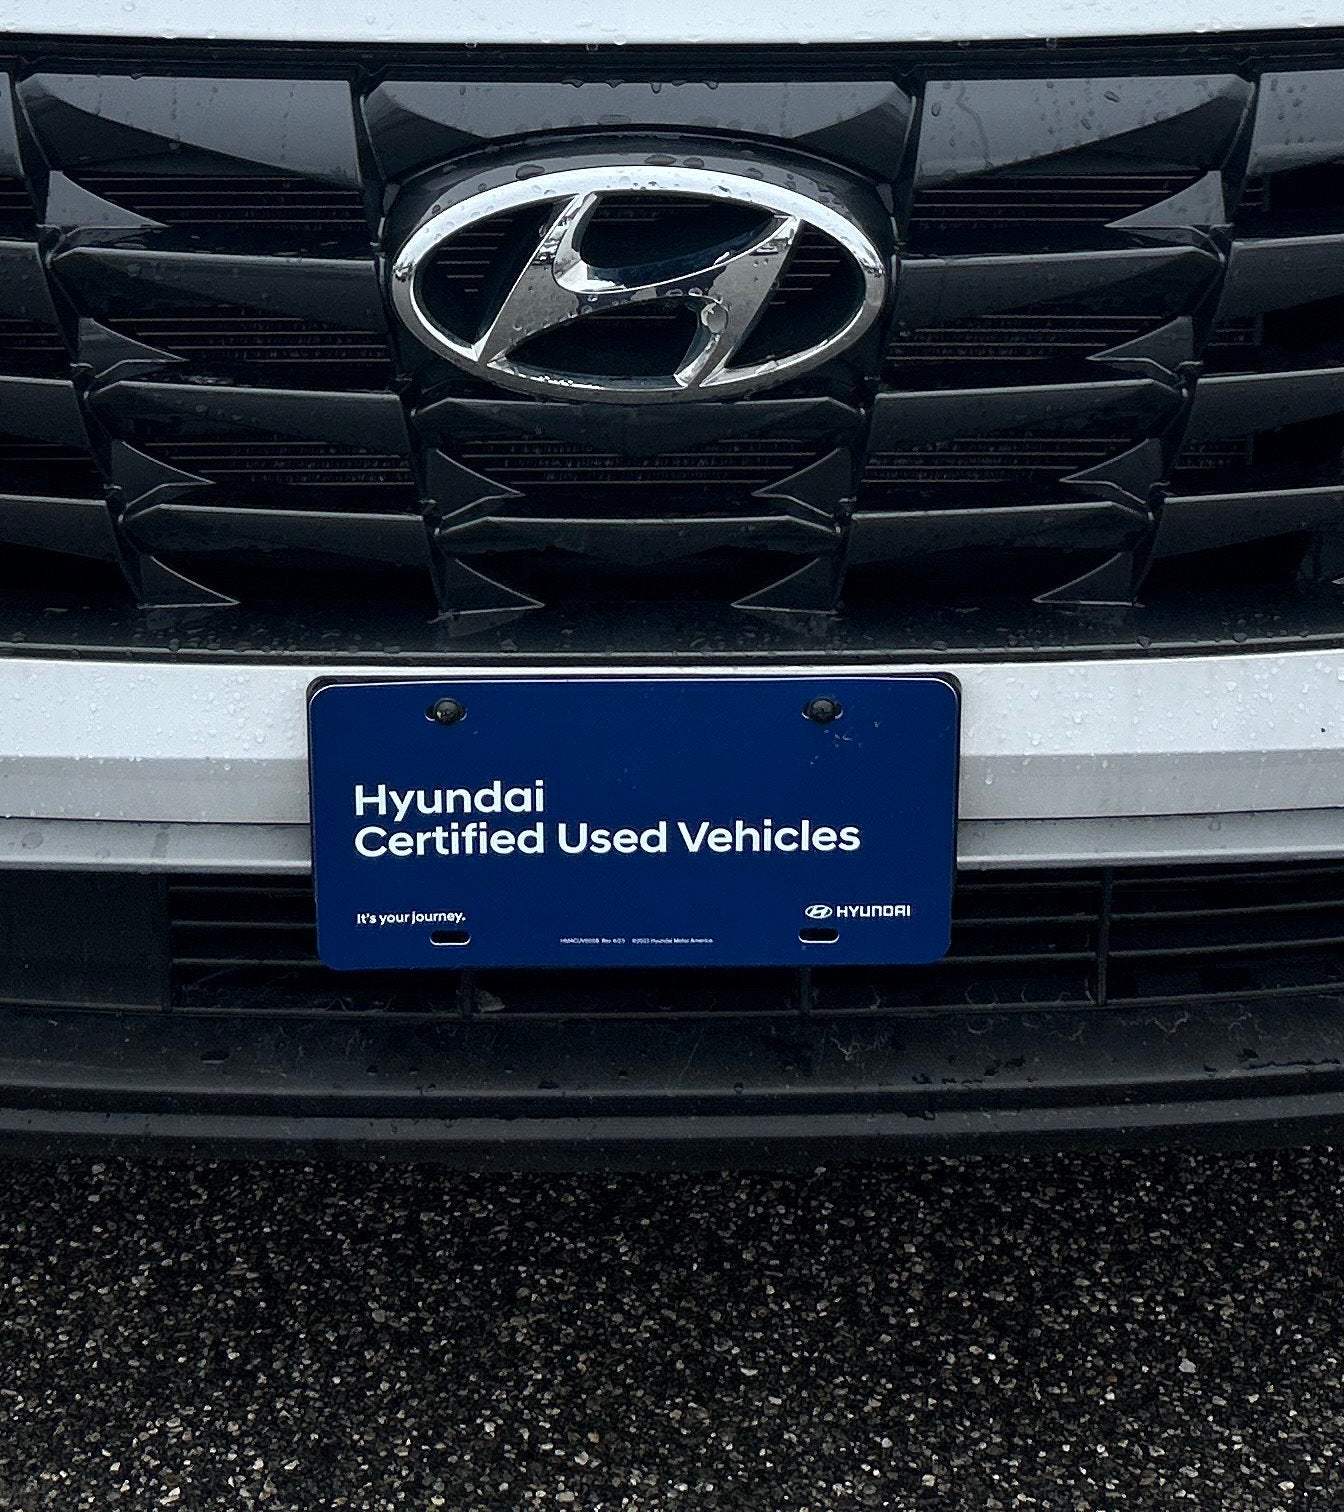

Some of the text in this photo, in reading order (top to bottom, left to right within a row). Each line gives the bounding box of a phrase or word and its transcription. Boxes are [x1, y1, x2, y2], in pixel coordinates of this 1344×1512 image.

[355, 779, 544, 822] Hyundai
[354, 818, 861, 858] Certified Used Vehicles
[357, 910, 466, 925] It's your journey.
[836, 904, 911, 918] HYUNDAI
